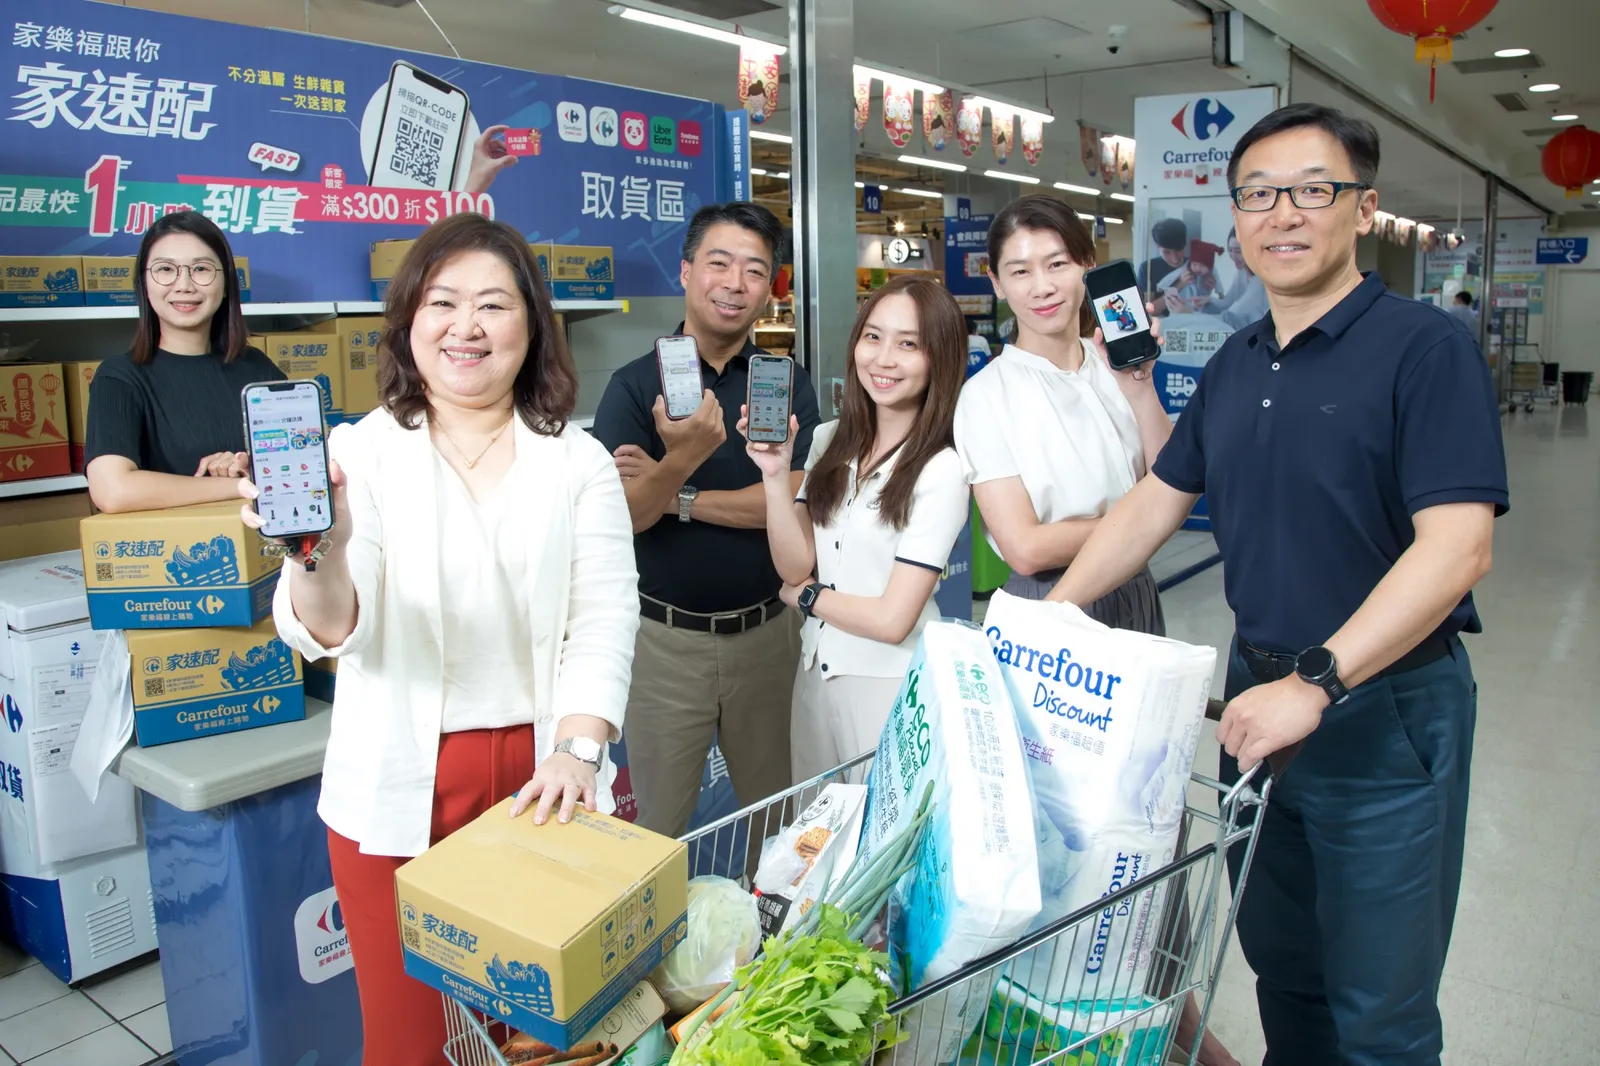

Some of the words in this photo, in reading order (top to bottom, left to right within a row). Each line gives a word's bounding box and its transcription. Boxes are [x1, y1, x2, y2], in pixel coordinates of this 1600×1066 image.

[12, 22, 162, 63] 家樂福跟你
[228, 65, 285, 88] 不分溫層
[293, 75, 346, 96] 生鮮雜貨
[5, 61, 218, 141] 家速配
[280, 94, 347, 114] 一次送到家
[398, 87, 457, 122] 掃描QR-CODE
[653, 124, 672, 135] Uber
[653, 135, 672, 146] Eats
[253, 147, 298, 169] FAST
[324, 167, 343, 179] 新客
[324, 178, 344, 190] 限定
[581, 170, 686, 223] 取貨區
[867, 196, 879, 210] 10
[201, 184, 304, 235] 到貨
[959, 207, 969, 220] 09
[6, 266, 39, 278] 家速配
[100, 267, 130, 278] 家速配
[291, 343, 328, 357] 家速配
[17, 378, 32, 421] 國泰民安
[114, 539, 165, 559] 家速配
[124, 598, 192, 613] Carrefour
[165, 648, 221, 672] 家速配
[986, 625, 1121, 700] Carrefour
[176, 702, 248, 724] Carrefour
[1033, 682, 1113, 733] Discount
[913, 703, 931, 767] eco
[1049, 722, 1106, 757] 家樂福超值
[1117, 852, 1142, 917] Disount
[422, 911, 480, 954] 家速配
[442, 973, 490, 1004] Carrefour
